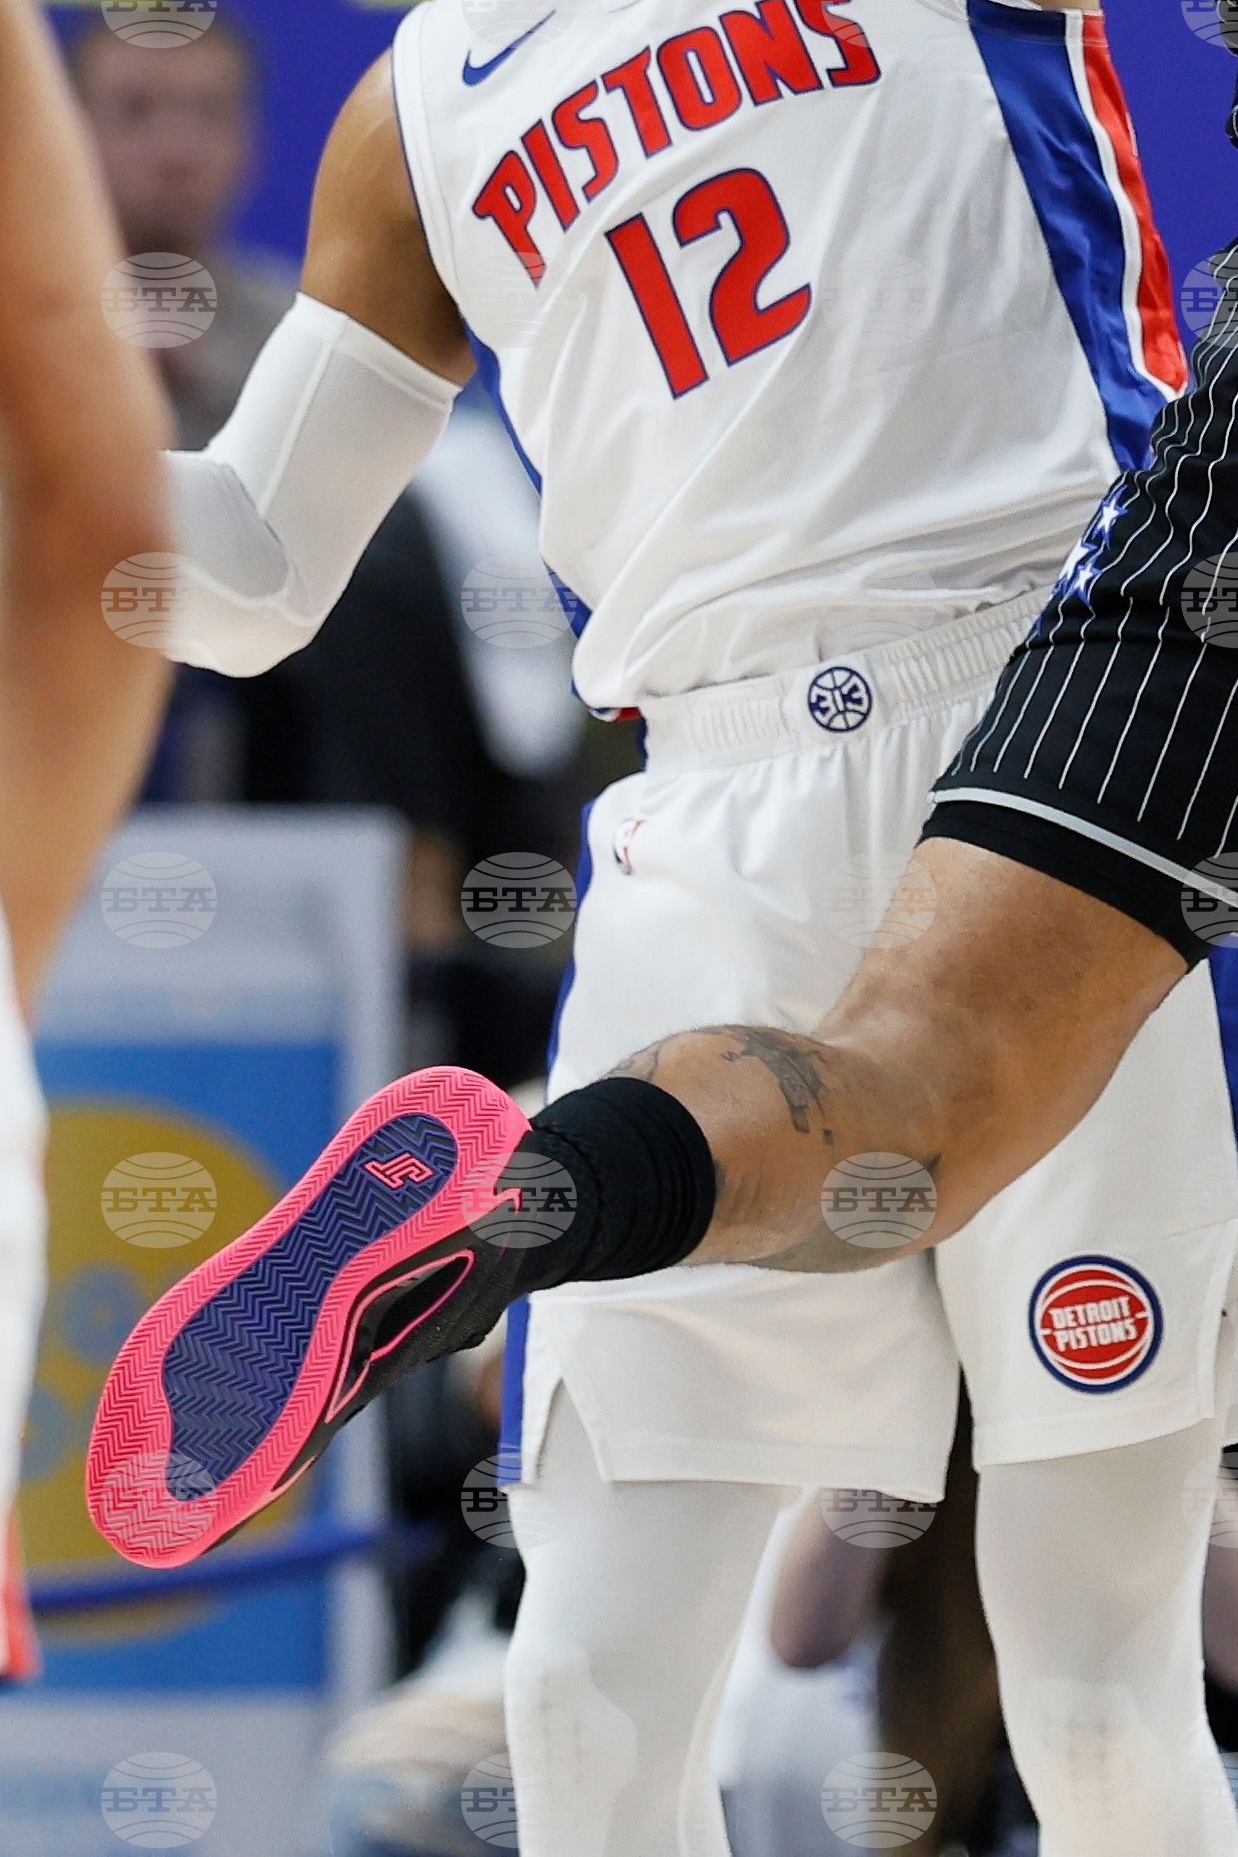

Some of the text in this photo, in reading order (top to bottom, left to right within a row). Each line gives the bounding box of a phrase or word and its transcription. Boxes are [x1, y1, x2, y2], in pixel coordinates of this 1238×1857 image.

[604, 167, 812, 400] 12
[1049, 1295, 1131, 1329] DETROIT
[1053, 1318, 1139, 1352] PISTONS
